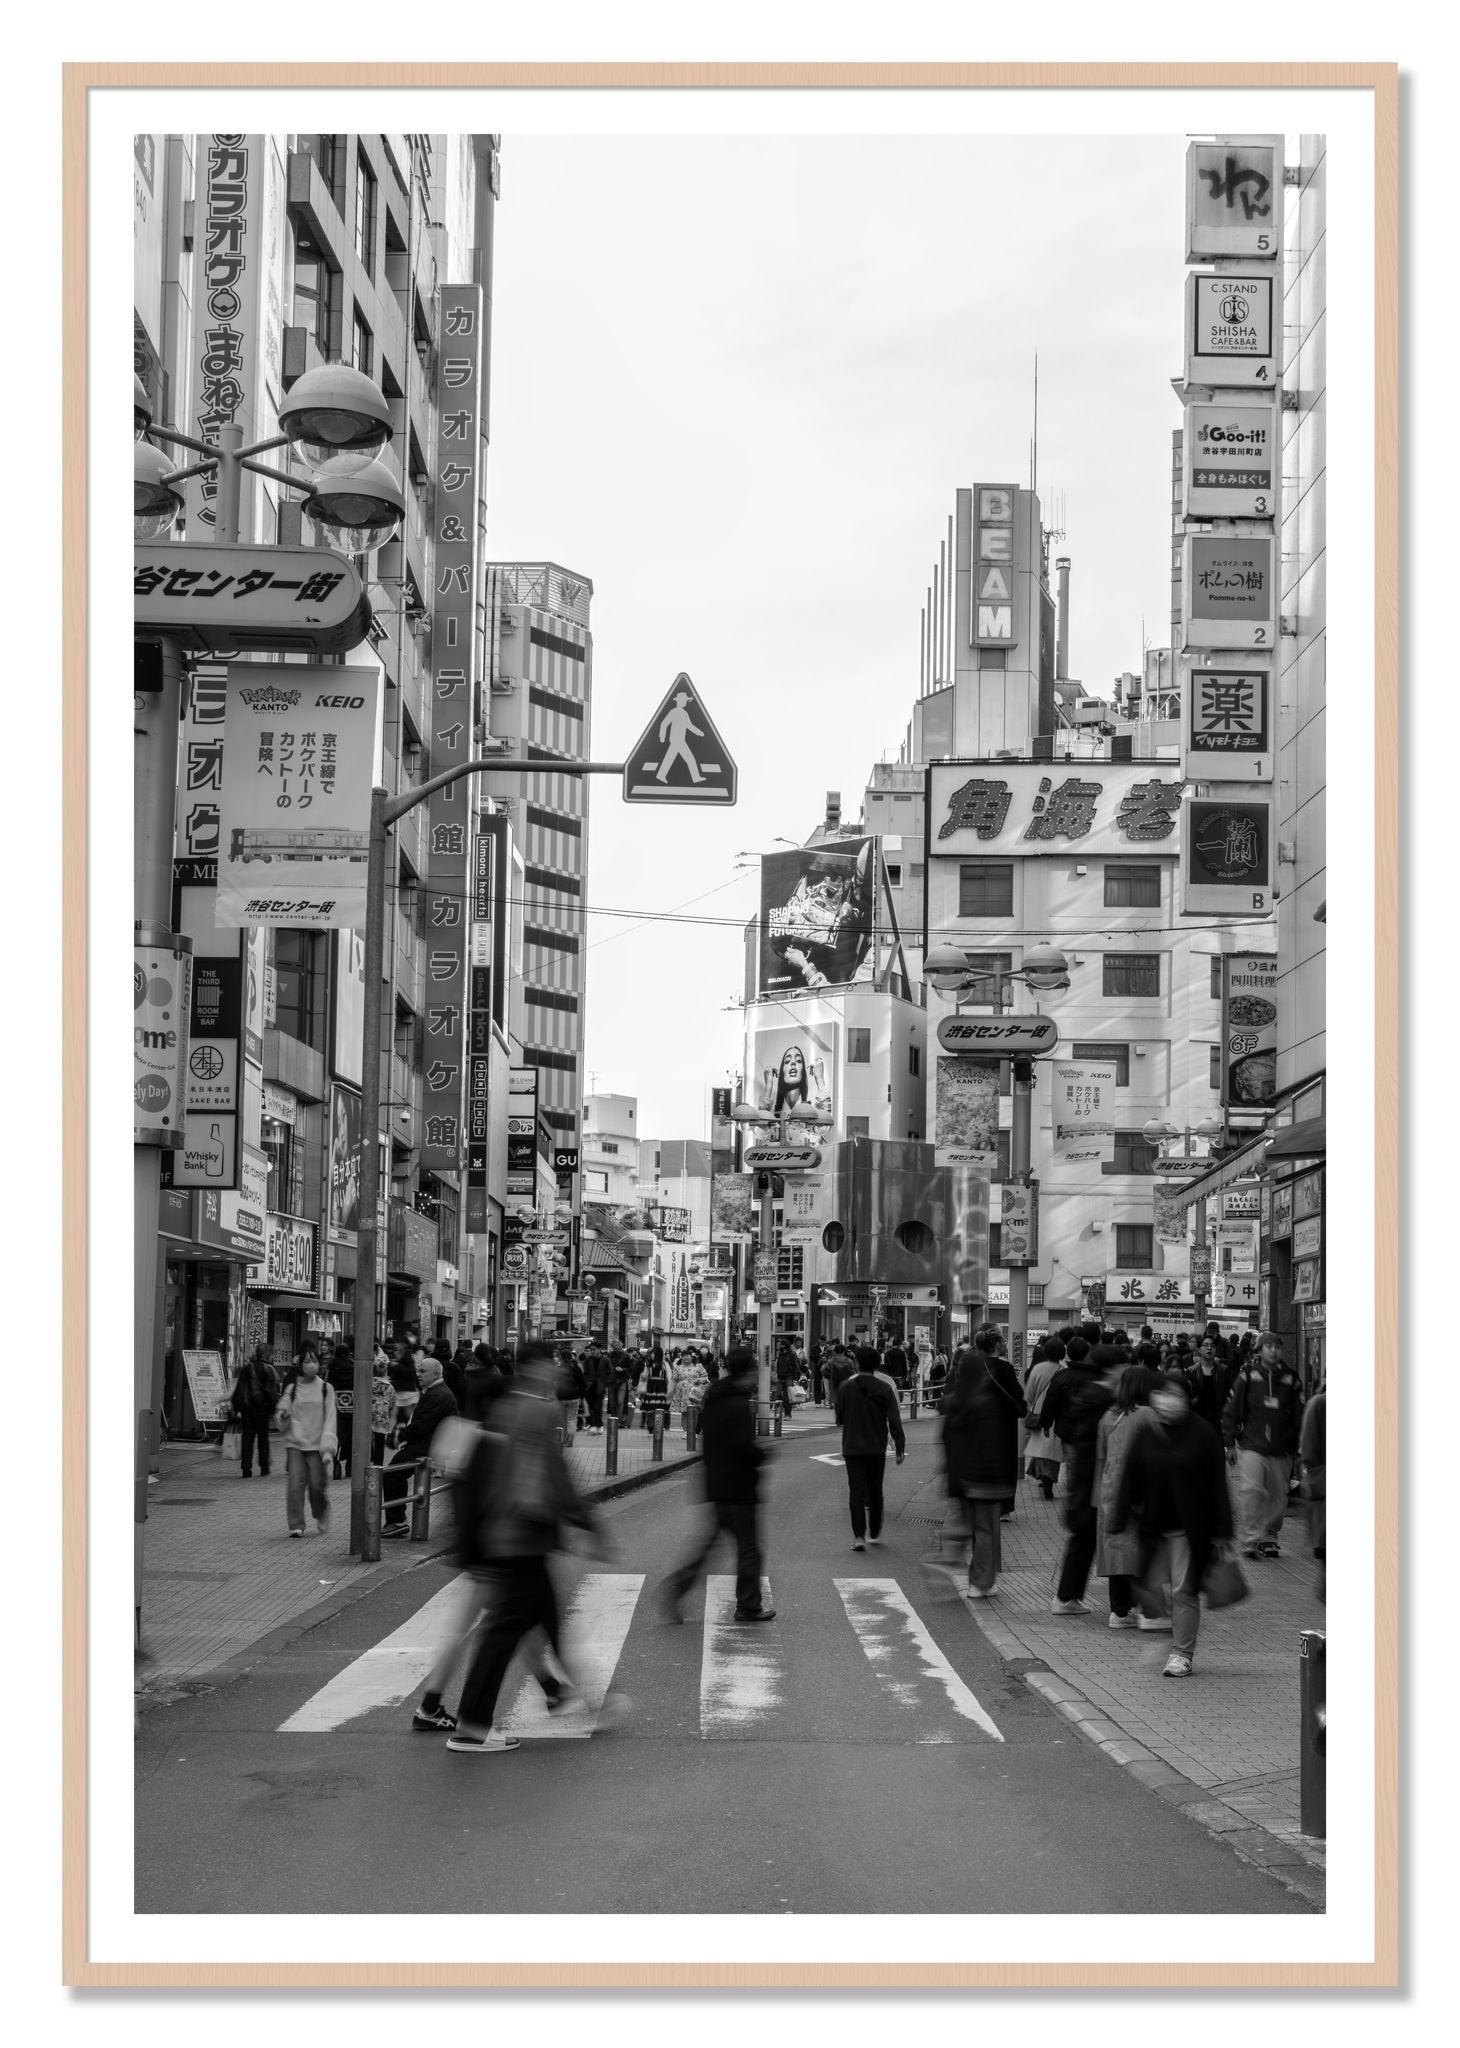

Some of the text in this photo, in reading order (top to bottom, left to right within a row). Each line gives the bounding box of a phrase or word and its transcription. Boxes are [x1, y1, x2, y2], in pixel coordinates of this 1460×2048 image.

[205, 147, 248, 289] カラオケ
[1257, 234, 1269, 250] 5
[1211, 284, 1258, 294] C.STAND
[1211, 326, 1257, 337] SHISHA
[1211, 337, 1257, 347] CAFE&BAR
[1256, 366, 1268, 381] 4
[1210, 426, 1265, 443] Goo-it!
[1197, 473, 1267, 485] 全身もみほぐし
[1254, 496, 1267, 514] 3
[978, 488, 1011, 639] BEAM
[134, 566, 346, 603] 谷センター街
[1198, 570, 1264, 590] ポムの樹
[1208, 594, 1256, 602] Pomme-no-ki
[1254, 628, 1266, 644] 2
[252, 703, 289, 711] KANTO
[315, 695, 365, 709] KEIO
[1201, 678, 1254, 731] 薬
[257, 732, 274, 776] 冒険へ
[277, 732, 295, 809] カントーの
[298, 732, 317, 809] ポケパーク
[320, 733, 338, 795] 京王線で
[1253, 761, 1263, 776] 1
[938, 778, 1186, 840] 角海老
[1196, 818, 1259, 867] 一蘭
[478, 839, 488, 916] kimono hearts
[244, 900, 336, 913] 渋谷センター街
[1252, 893, 1264, 909] B
[201, 1018, 215, 1026] BAR
[945, 1025, 1051, 1038] 渋谷センター街
[1229, 1034, 1258, 1054] 6F
[148, 1084, 169, 1099] Day!
[184, 1151, 219, 1163] Whisky
[556, 1155, 577, 1166] GU
[748, 1151, 811, 1161] 渋谷センター街
[184, 1161, 206, 1170] Bank
[1156, 1161, 1215, 1170] 渋谷センター街
[1120, 1278, 1182, 1300] 兆楽
[678, 1276, 689, 1320] BEER
